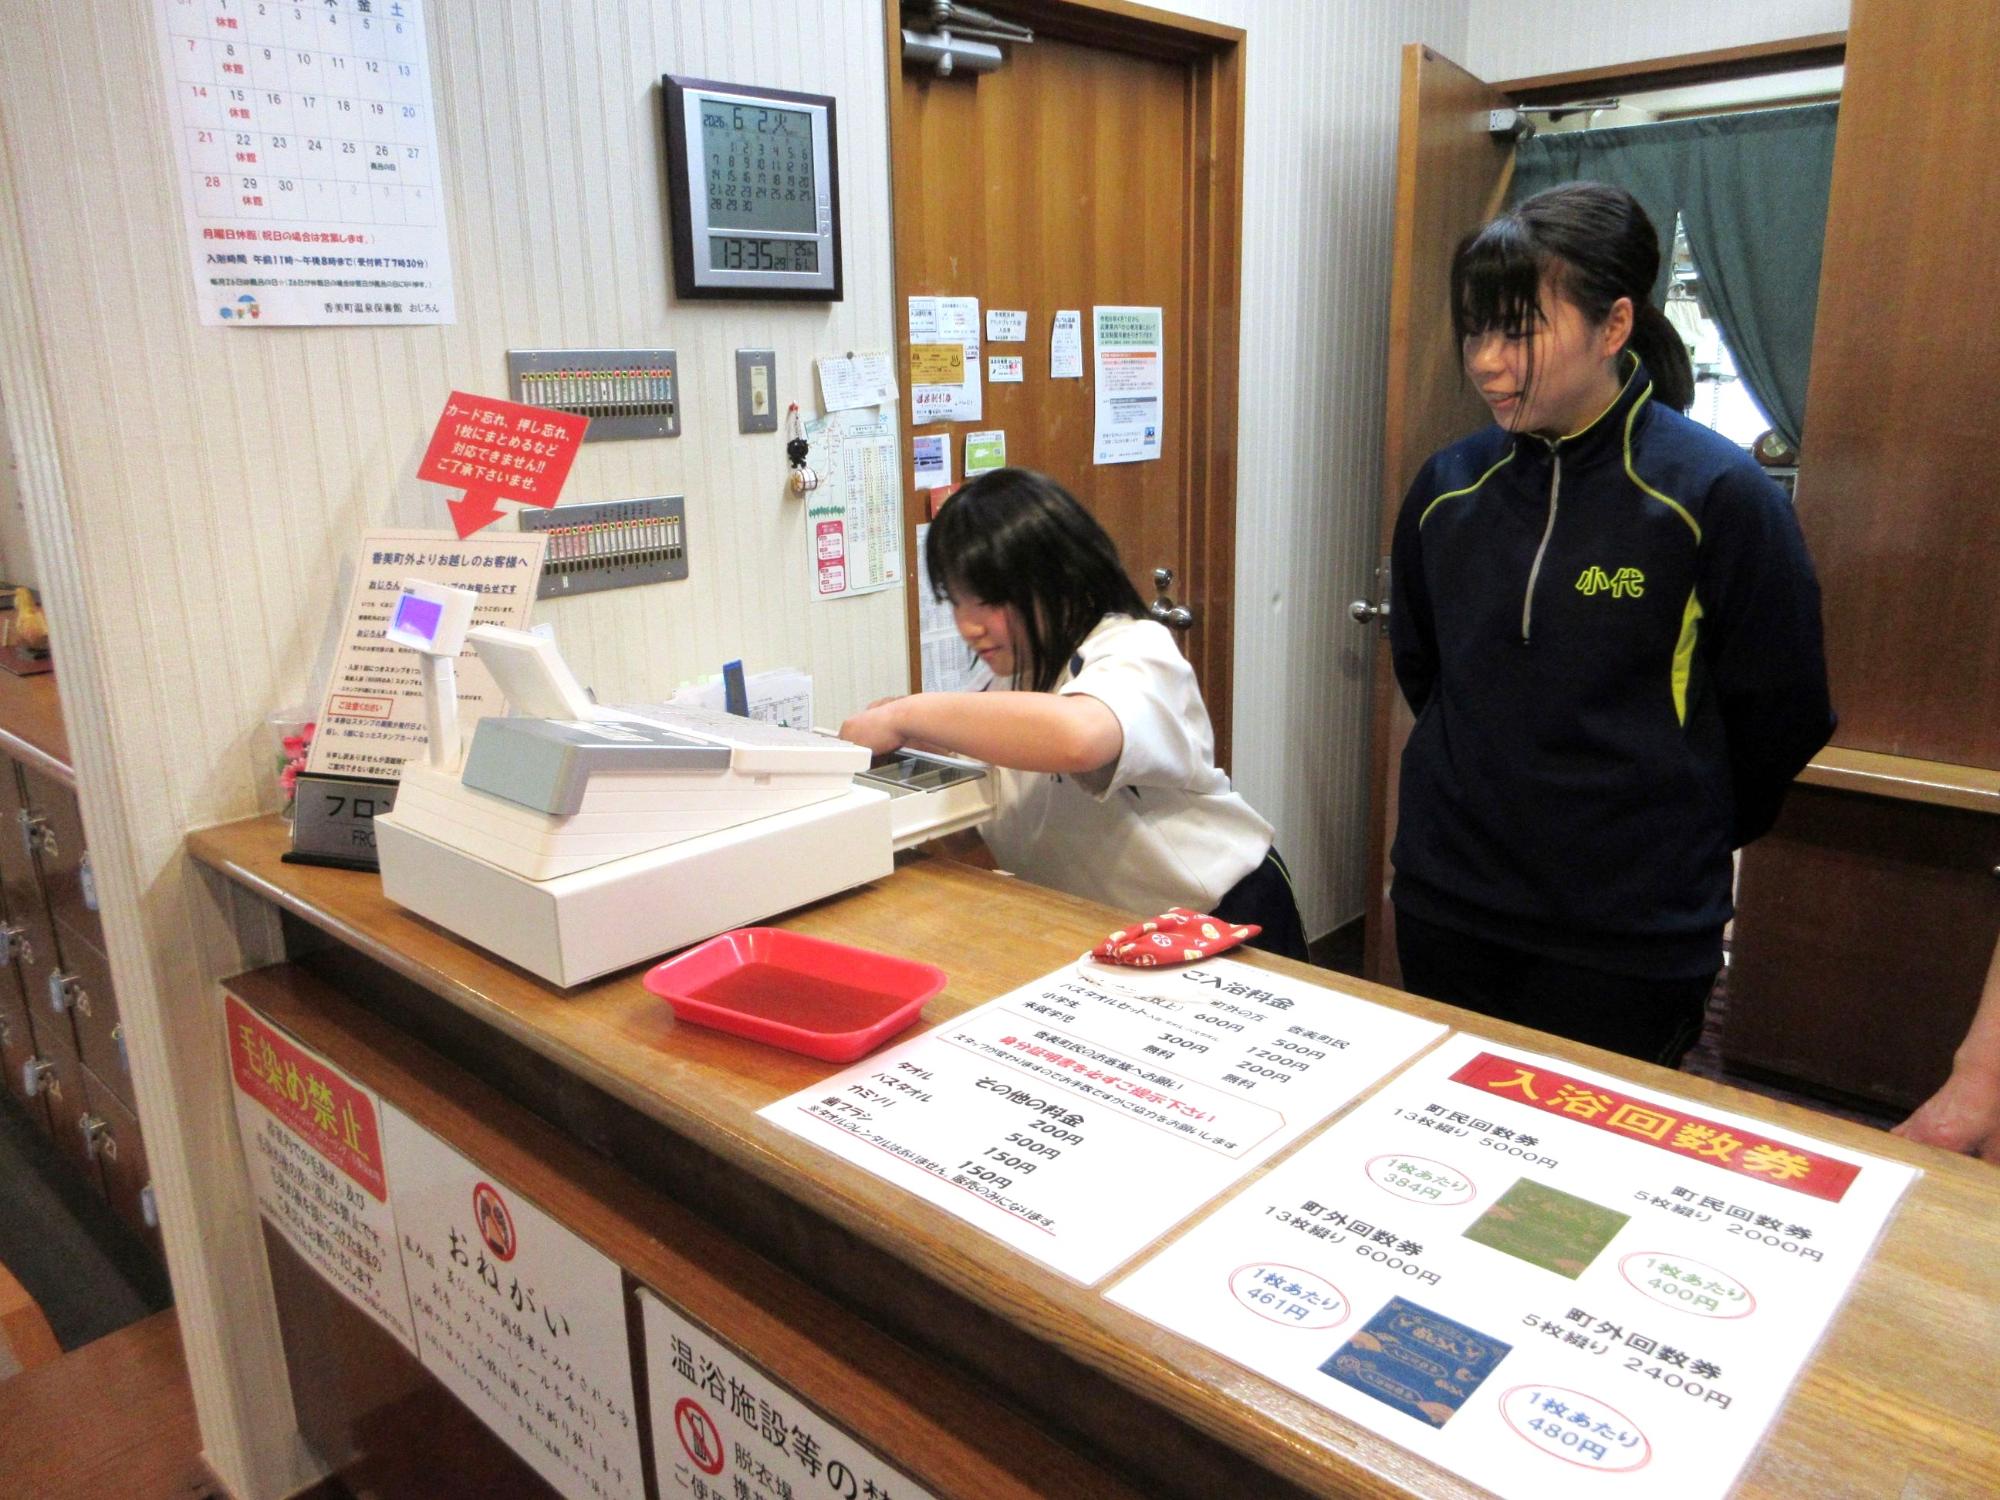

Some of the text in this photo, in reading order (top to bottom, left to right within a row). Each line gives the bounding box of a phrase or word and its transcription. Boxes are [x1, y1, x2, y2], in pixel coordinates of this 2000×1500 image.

[216, 17, 238, 30] 休館
[259, 4, 265, 15] 2
[295, 9, 301, 20] 3
[330, 14, 336, 25] 4
[364, 18, 370, 30] 5
[396, 23, 402, 34] 6
[391, 4, 403, 18] 土
[188, 40, 410, 76] 7 8 9 10 11 12 13
[222, 62, 244, 75] 休館
[192, 87, 416, 118] 14 15 16 17 18 19 20
[229, 107, 250, 120] 休館
[734, 107, 744, 130] 6
[758, 110, 768, 133] 2
[198, 132, 420, 158] 21 22 23 24 25 26 27
[236, 152, 257, 164] 休館
[205, 177, 220, 188] 28
[242, 179, 258, 190] 29
[278, 180, 293, 192] 30
[242, 196, 264, 207] 休館
[455, 424, 559, 457] 1枚にまとめるなど
[1575, 566, 1644, 598] 小代
[326, 795, 390, 818] フロ
[1182, 968, 1296, 1012] ご入浴料金
[1023, 1000, 1257, 1090] 未就学児 無料 無料
[1042, 992, 1292, 1084] 小学生 300円 200円
[1194, 1012, 1245, 1034] 600円
[1271, 1038, 1327, 1060] 500円
[1285, 1026, 1351, 1050] 香美町民
[999, 1034, 1216, 1123] 身分証明書を必ずご提示下さい
[1033, 1030, 1184, 1092] 香美町民のお客様へお願い
[1246, 1046, 1310, 1072] 1200円
[239, 1022, 371, 1162] 毛染め禁止
[897, 1062, 1085, 1147] タオル 200円
[974, 1076, 1085, 1128] その他の料金
[848, 1084, 1038, 1175] カミソリ 150円
[872, 1072, 1062, 1160] バスタオル 500円
[1424, 1102, 1540, 1148] 町民回数券
[1488, 1068, 1812, 1182] 入浴回数券
[820, 1095, 1013, 1190] 歯ブラシ 150円
[1393, 1107, 1558, 1170] 13枚綴り 5000円
[1383, 1172, 1442, 1200] 384円
[1386, 1158, 1468, 1193] 1枚あたり
[1300, 1200, 1424, 1257] 町外回数券
[1633, 1190, 1824, 1264] 5枚綴り 2000円
[1670, 1184, 1814, 1240] 町民回数券
[1264, 1204, 1442, 1286] 13枚綴り 6000円
[448, 1226, 570, 1338] おねがい
[1252, 1268, 1340, 1311] 1枚あたり
[1646, 1258, 1746, 1302] 1枚あたり
[1647, 1277, 1720, 1312] 400円
[1247, 1288, 1310, 1321] 461円
[1522, 1314, 1732, 1410] 5枚綴り 2400円
[1565, 1307, 1723, 1380] 町外回数券
[1527, 1418, 1608, 1462] 480円
[1528, 1392, 1640, 1449] 1枚あたり
